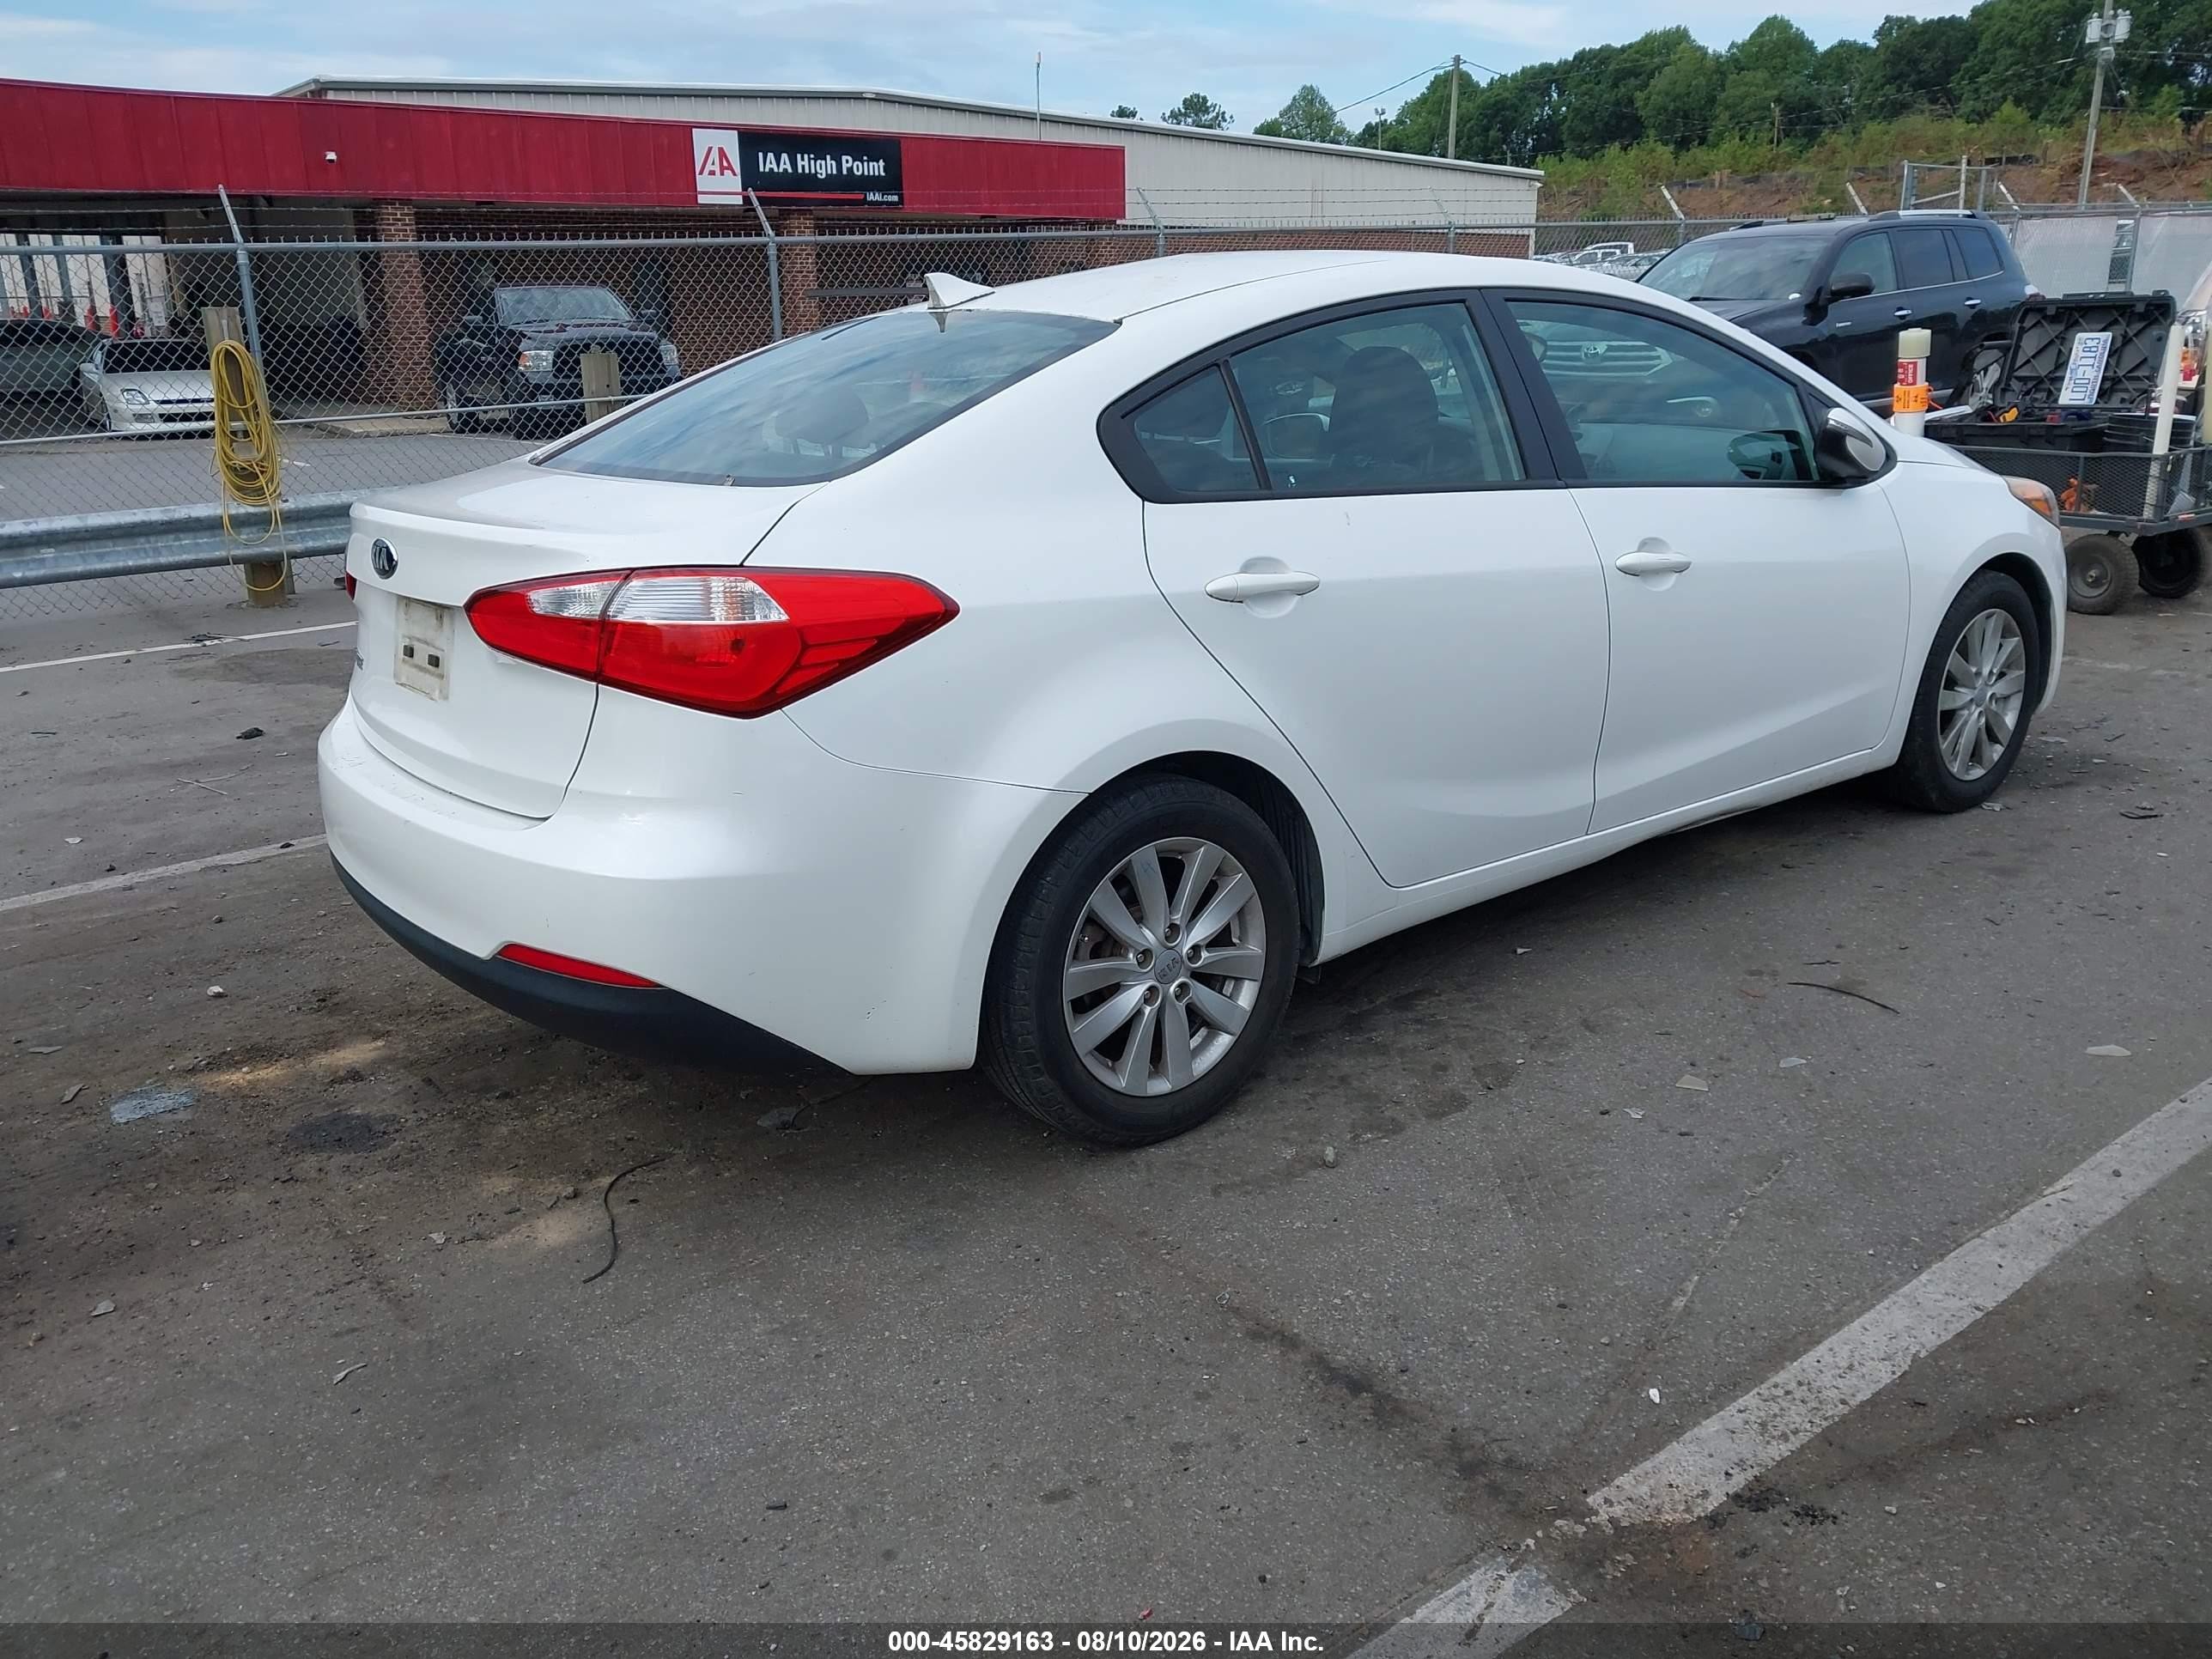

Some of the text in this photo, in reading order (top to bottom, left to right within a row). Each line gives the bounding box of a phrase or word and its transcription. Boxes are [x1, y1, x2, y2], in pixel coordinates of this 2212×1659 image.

[757, 151, 886, 179] IAA High Point
[2069, 337, 2101, 401] LDD-1183
